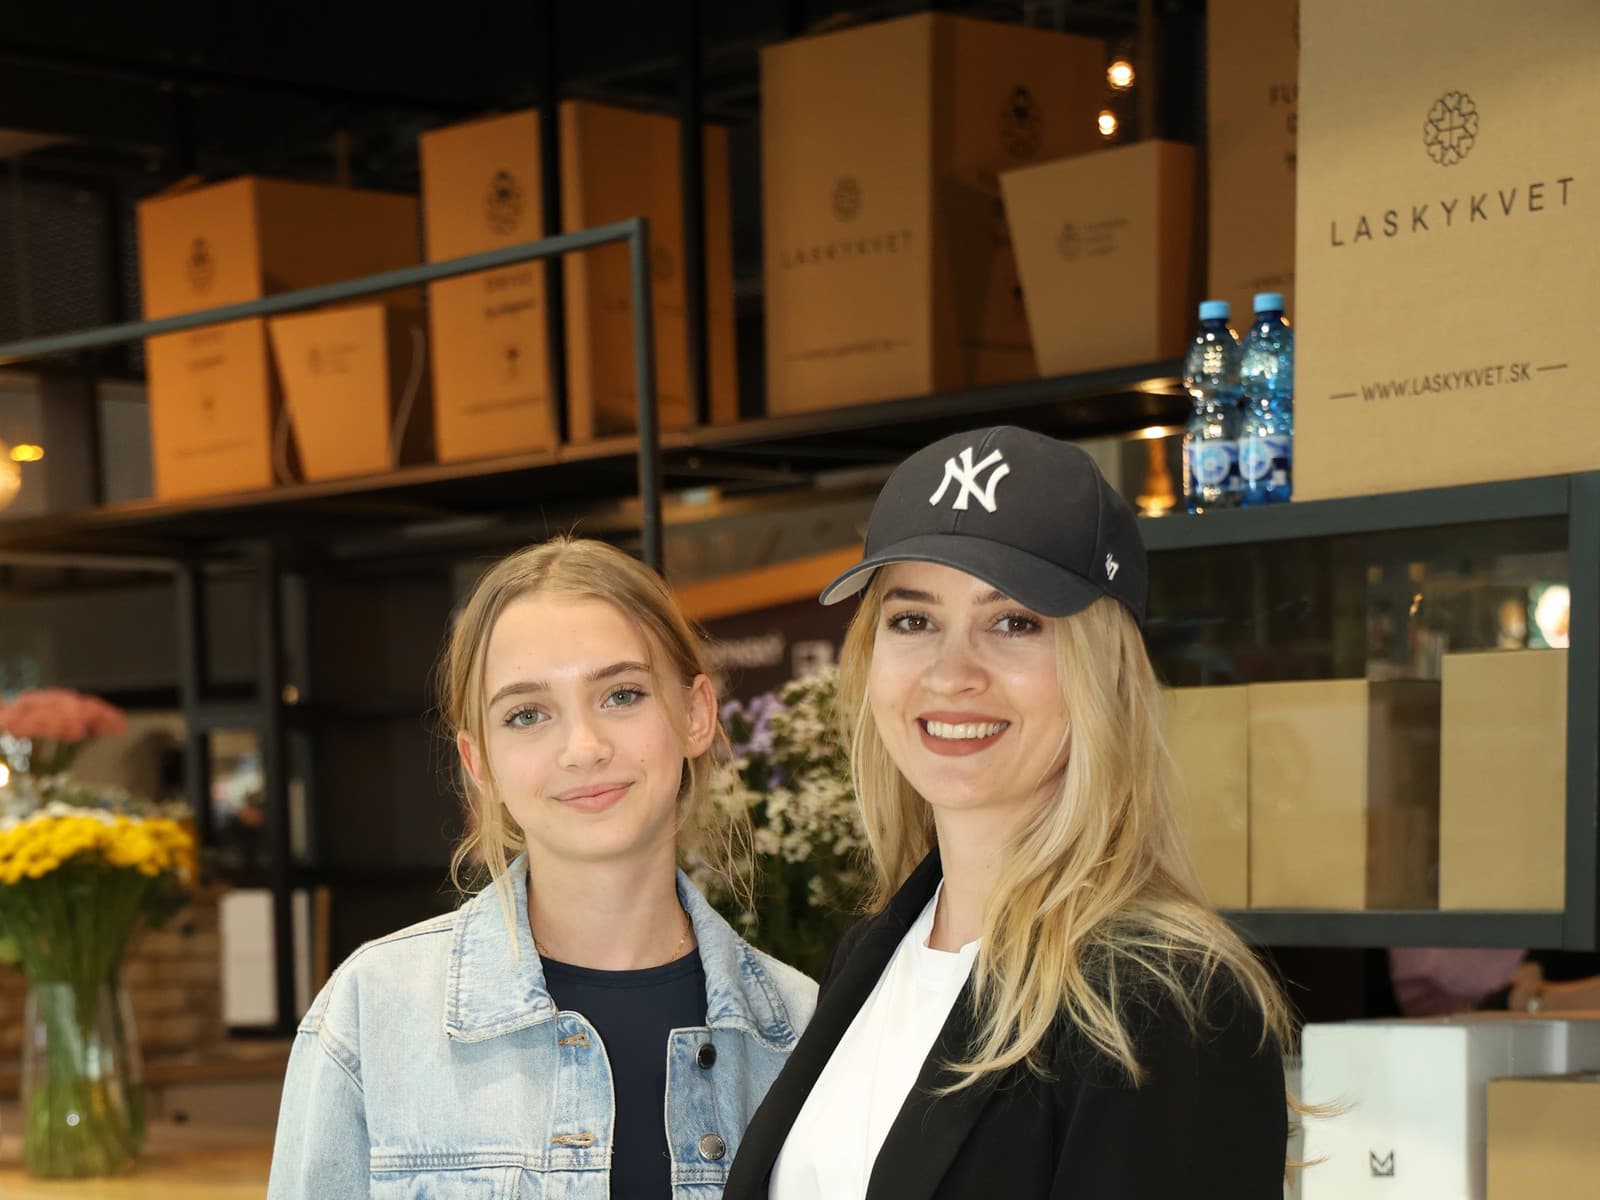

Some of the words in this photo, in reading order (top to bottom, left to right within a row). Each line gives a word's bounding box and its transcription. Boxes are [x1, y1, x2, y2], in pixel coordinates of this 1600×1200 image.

[1331, 177, 1574, 247] LASKYKVET
[1361, 362, 1531, 400] WWW.LASKYKVET.SK
[929, 447, 1010, 512] NY
